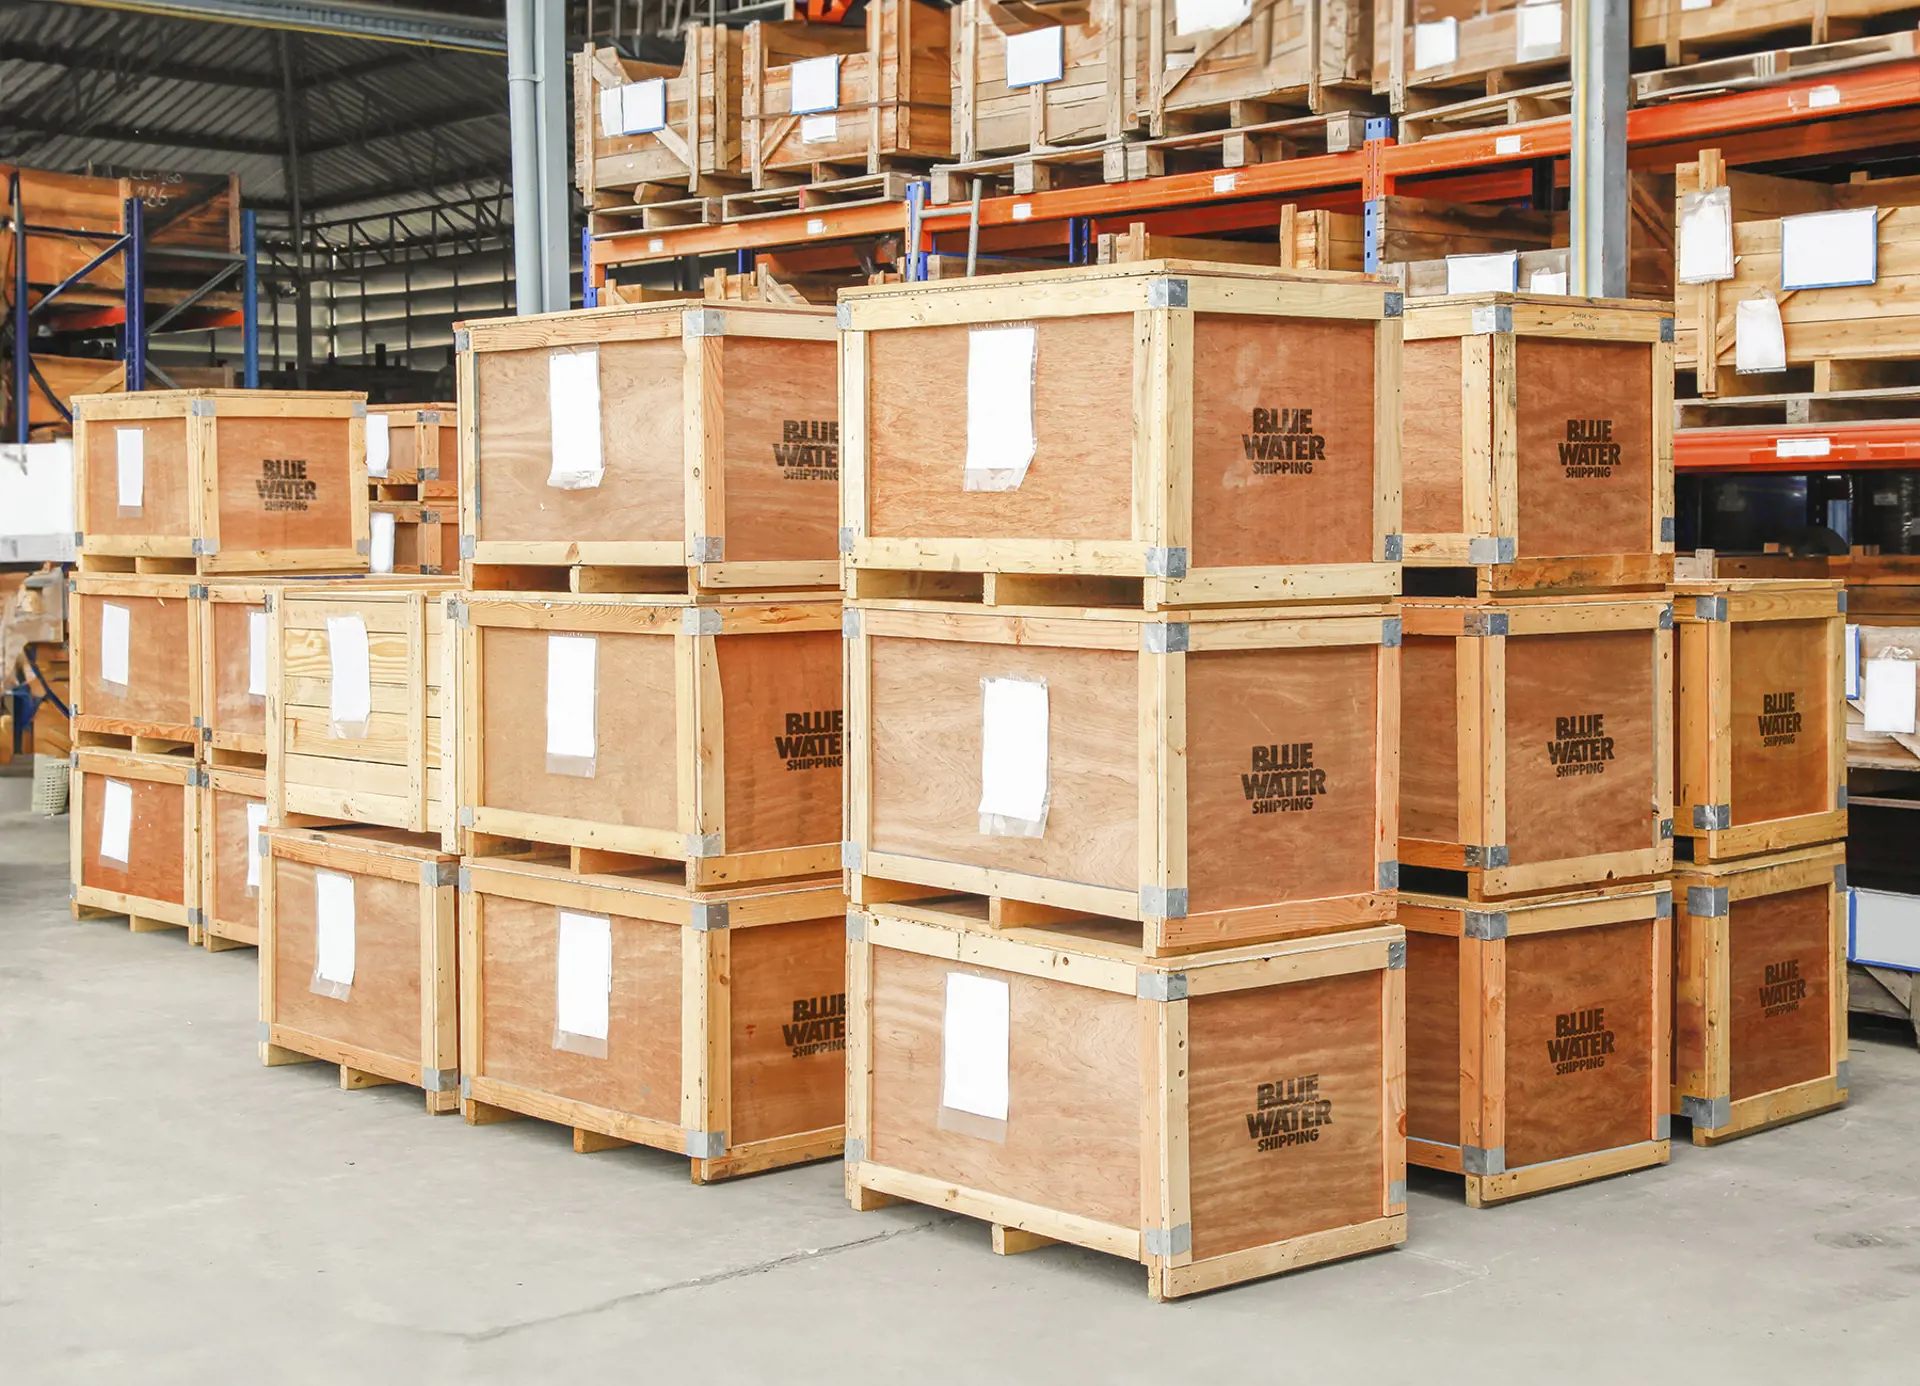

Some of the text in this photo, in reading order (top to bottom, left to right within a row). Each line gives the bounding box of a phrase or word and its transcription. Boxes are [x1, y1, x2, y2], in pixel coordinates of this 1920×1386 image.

[1253, 408, 1312, 434] BLUE
[1567, 420, 1612, 442] BLUE
[772, 444, 839, 467] WATE
[1241, 434, 1326, 460] WATER
[1557, 443, 1621, 466] WATER
[263, 460, 307, 479] BLUE
[1252, 461, 1313, 475] SHIPPING
[1566, 467, 1611, 478] SHIPPING
[256, 480, 317, 500] WATER
[264, 501, 308, 511] SHIPPING
[1764, 692, 1795, 714] BLUE
[785, 710, 843, 735] BLUE
[1556, 714, 1604, 740] BLUE
[1758, 712, 1802, 736] WATER
[774, 733, 843, 759] WATE
[1547, 737, 1615, 765] WATER
[1763, 733, 1796, 748] SHIPPING
[786, 756, 843, 771] SHIPPING
[1252, 743, 1313, 772] BLUE
[1556, 762, 1604, 777] SHIPPING
[1240, 769, 1327, 800] WATER
[1252, 797, 1313, 814] SHIPPING
[1765, 959, 1799, 985] BLUE
[1759, 978, 1806, 1008] WATER
[1764, 1000, 1799, 1019] SHIPPING
[782, 1016, 845, 1048] WATE
[1556, 1008, 1604, 1037] BLUE
[1546, 1031, 1615, 1063] WATER
[1556, 1056, 1604, 1075] SHIPPING
[1257, 1073, 1319, 1111] BLUE
[1246, 1099, 1333, 1139] WATER
[1257, 1128, 1319, 1153] SHIPPING
